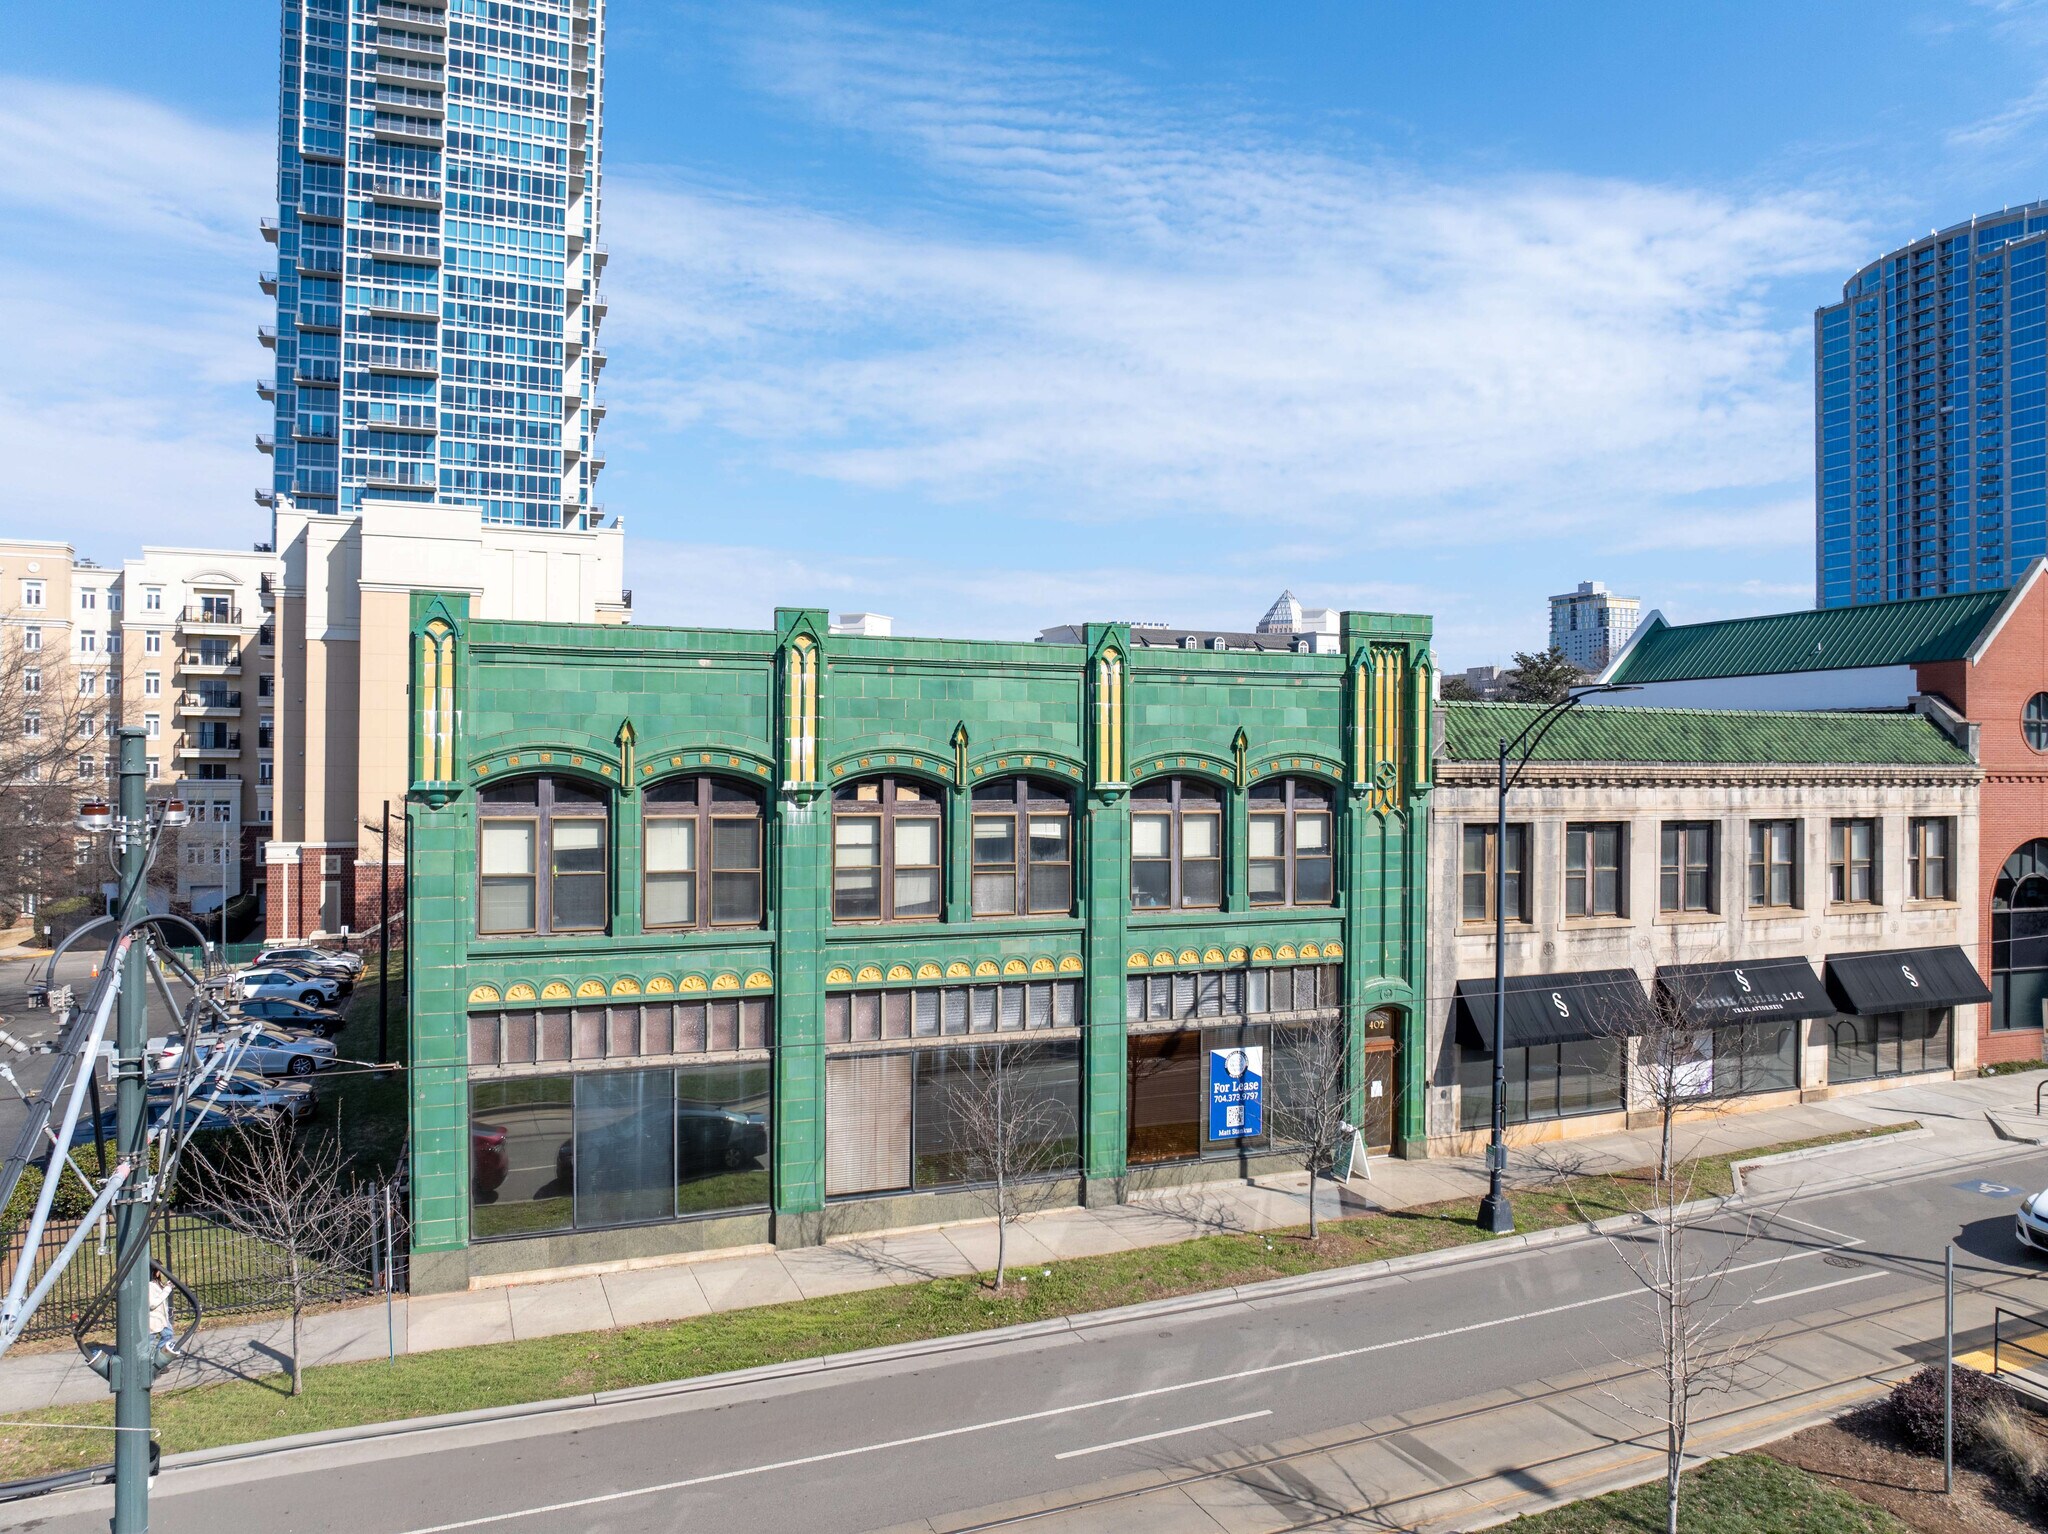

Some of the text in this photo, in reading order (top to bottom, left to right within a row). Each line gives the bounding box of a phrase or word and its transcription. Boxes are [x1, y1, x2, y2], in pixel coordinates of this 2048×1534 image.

[1369, 1020, 1385, 1030] 402
[1213, 1081, 1259, 1094] For Lease
[1213, 1091, 1259, 1104] 704.373.9797
[1218, 1129, 1231, 1137] Matt
